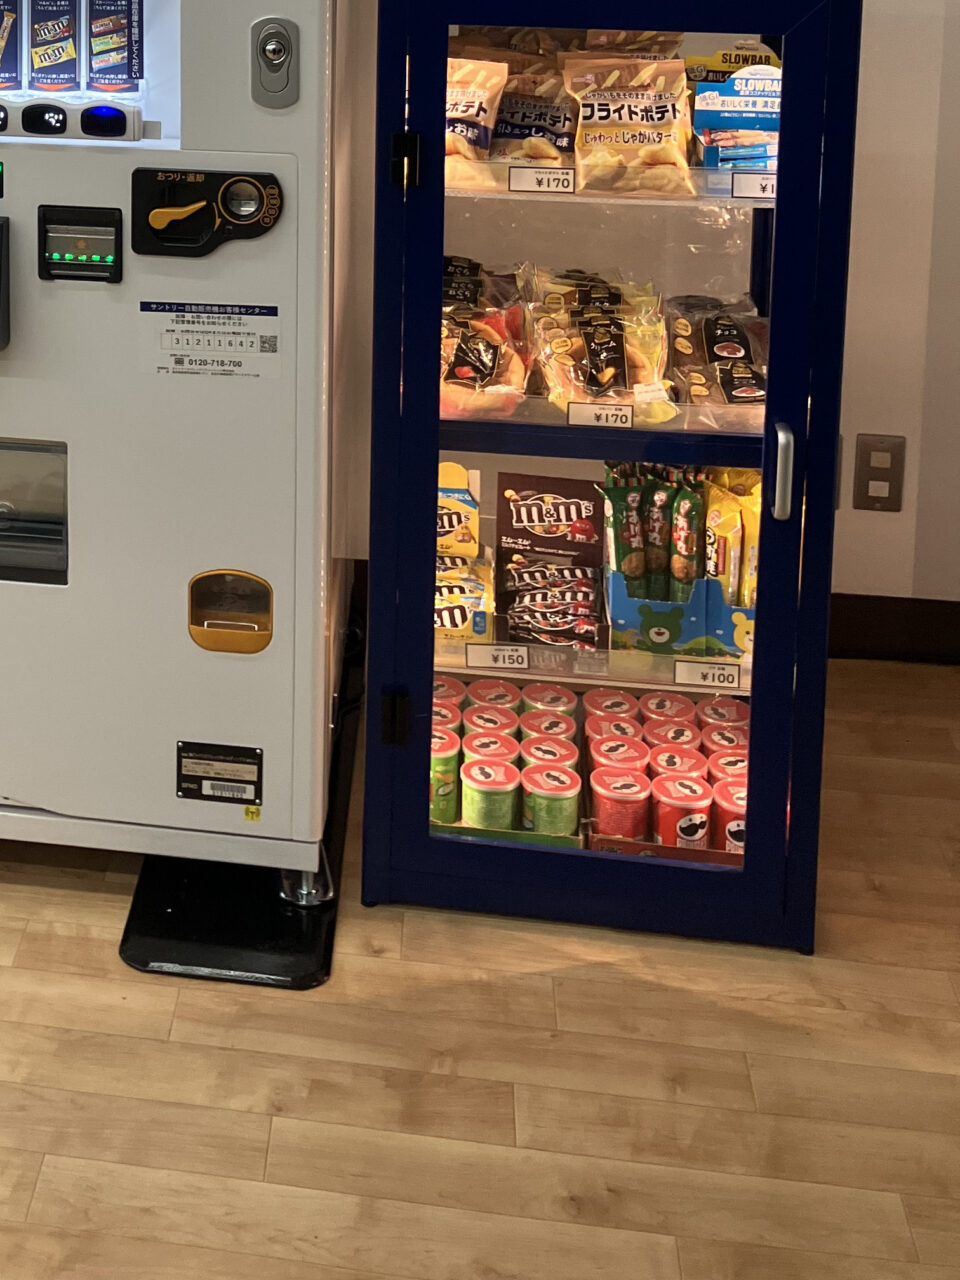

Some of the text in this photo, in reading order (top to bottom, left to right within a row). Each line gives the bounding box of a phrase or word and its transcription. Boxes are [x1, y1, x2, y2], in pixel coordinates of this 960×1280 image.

[721, 53, 771, 65] SLOWBAR
[581, 102, 681, 122] フライドポテト
[535, 177, 570, 188] ¥170
[150, 304, 268, 314] サントリー自動販売機お客様センター
[594, 412, 628, 424] ¥170
[510, 499, 594, 526] m&m's
[492, 654, 524, 665] ¥150
[701, 672, 735, 684] ¥100
